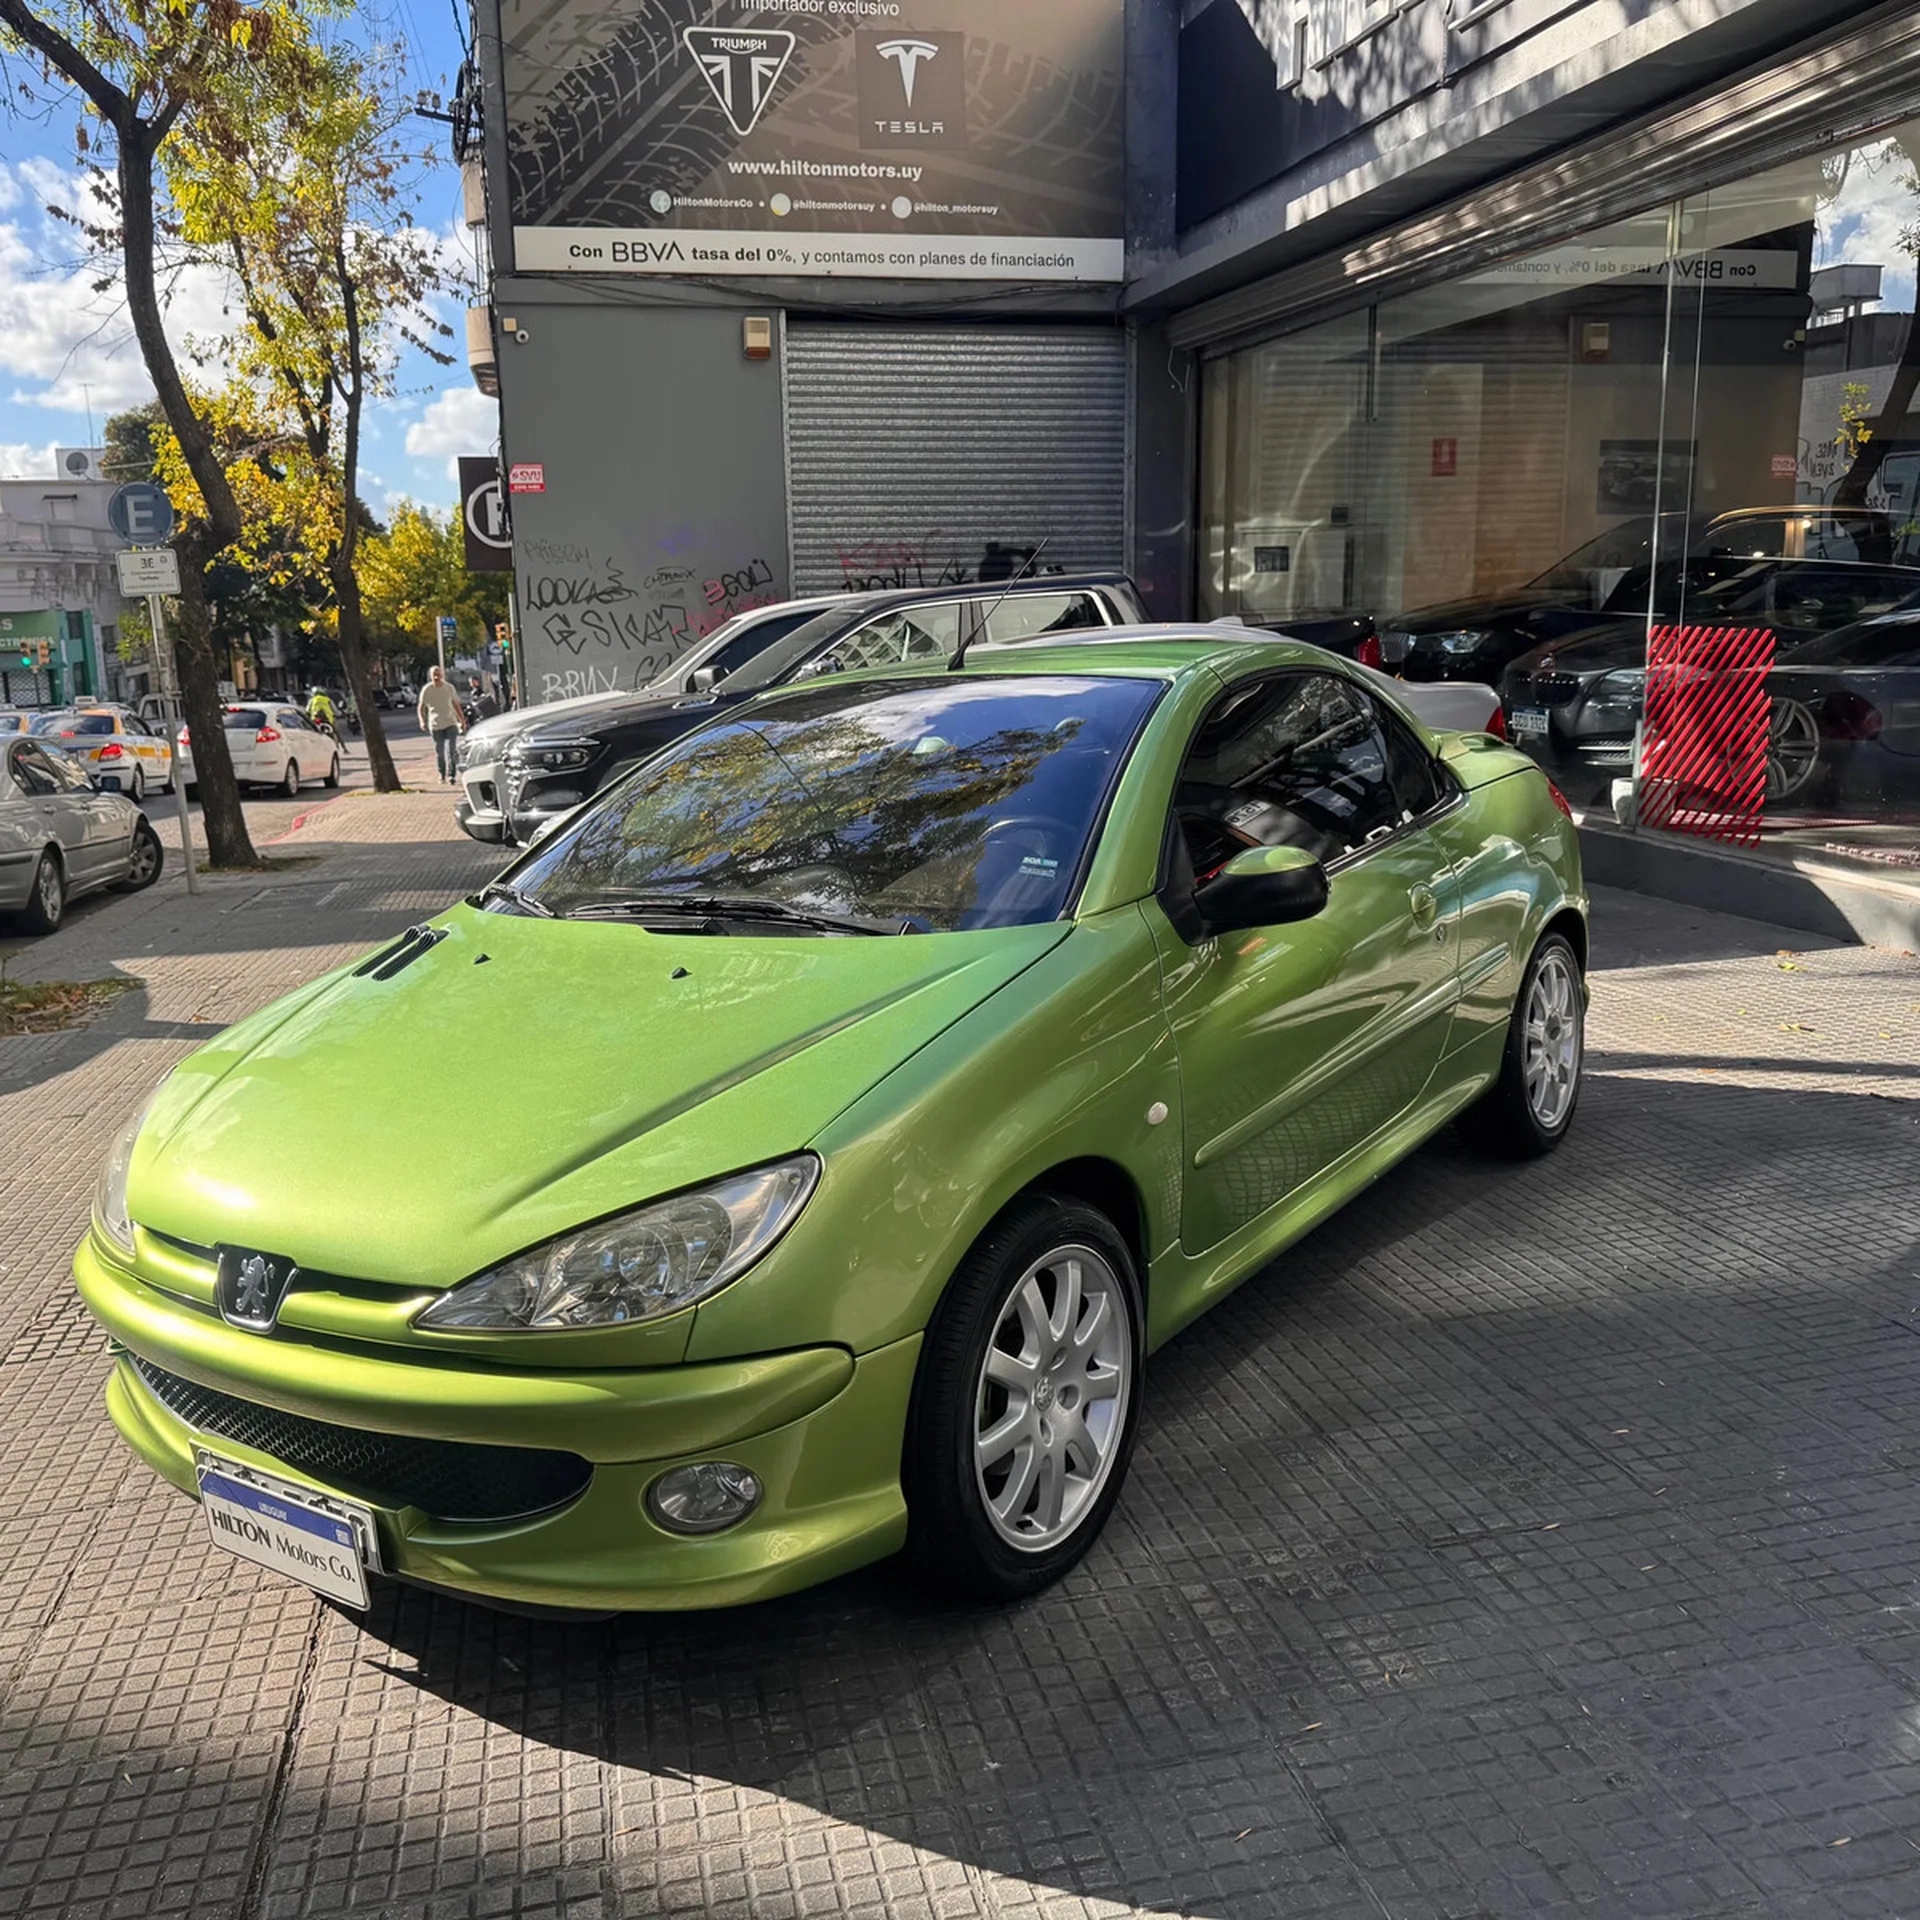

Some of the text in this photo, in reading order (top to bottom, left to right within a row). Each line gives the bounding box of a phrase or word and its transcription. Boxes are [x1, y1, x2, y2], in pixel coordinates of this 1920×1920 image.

[828, 0, 899, 16] exclusivo
[711, 37, 767, 51] TRIUMPH
[874, 121, 944, 134] TESLA
[728, 160, 922, 182] www.hiltonmotors.uy
[673, 196, 753, 208] HiltonMotorsCo
[569, 240, 1074, 267] Con BBVA tasa del 0%, y contamos con planes de financiación
[519, 470, 541, 481] SVU
[126, 495, 157, 534] E
[211, 1508, 272, 1549] HILTON
[276, 1534, 327, 1572] Motors
[329, 1556, 356, 1583] Co.
